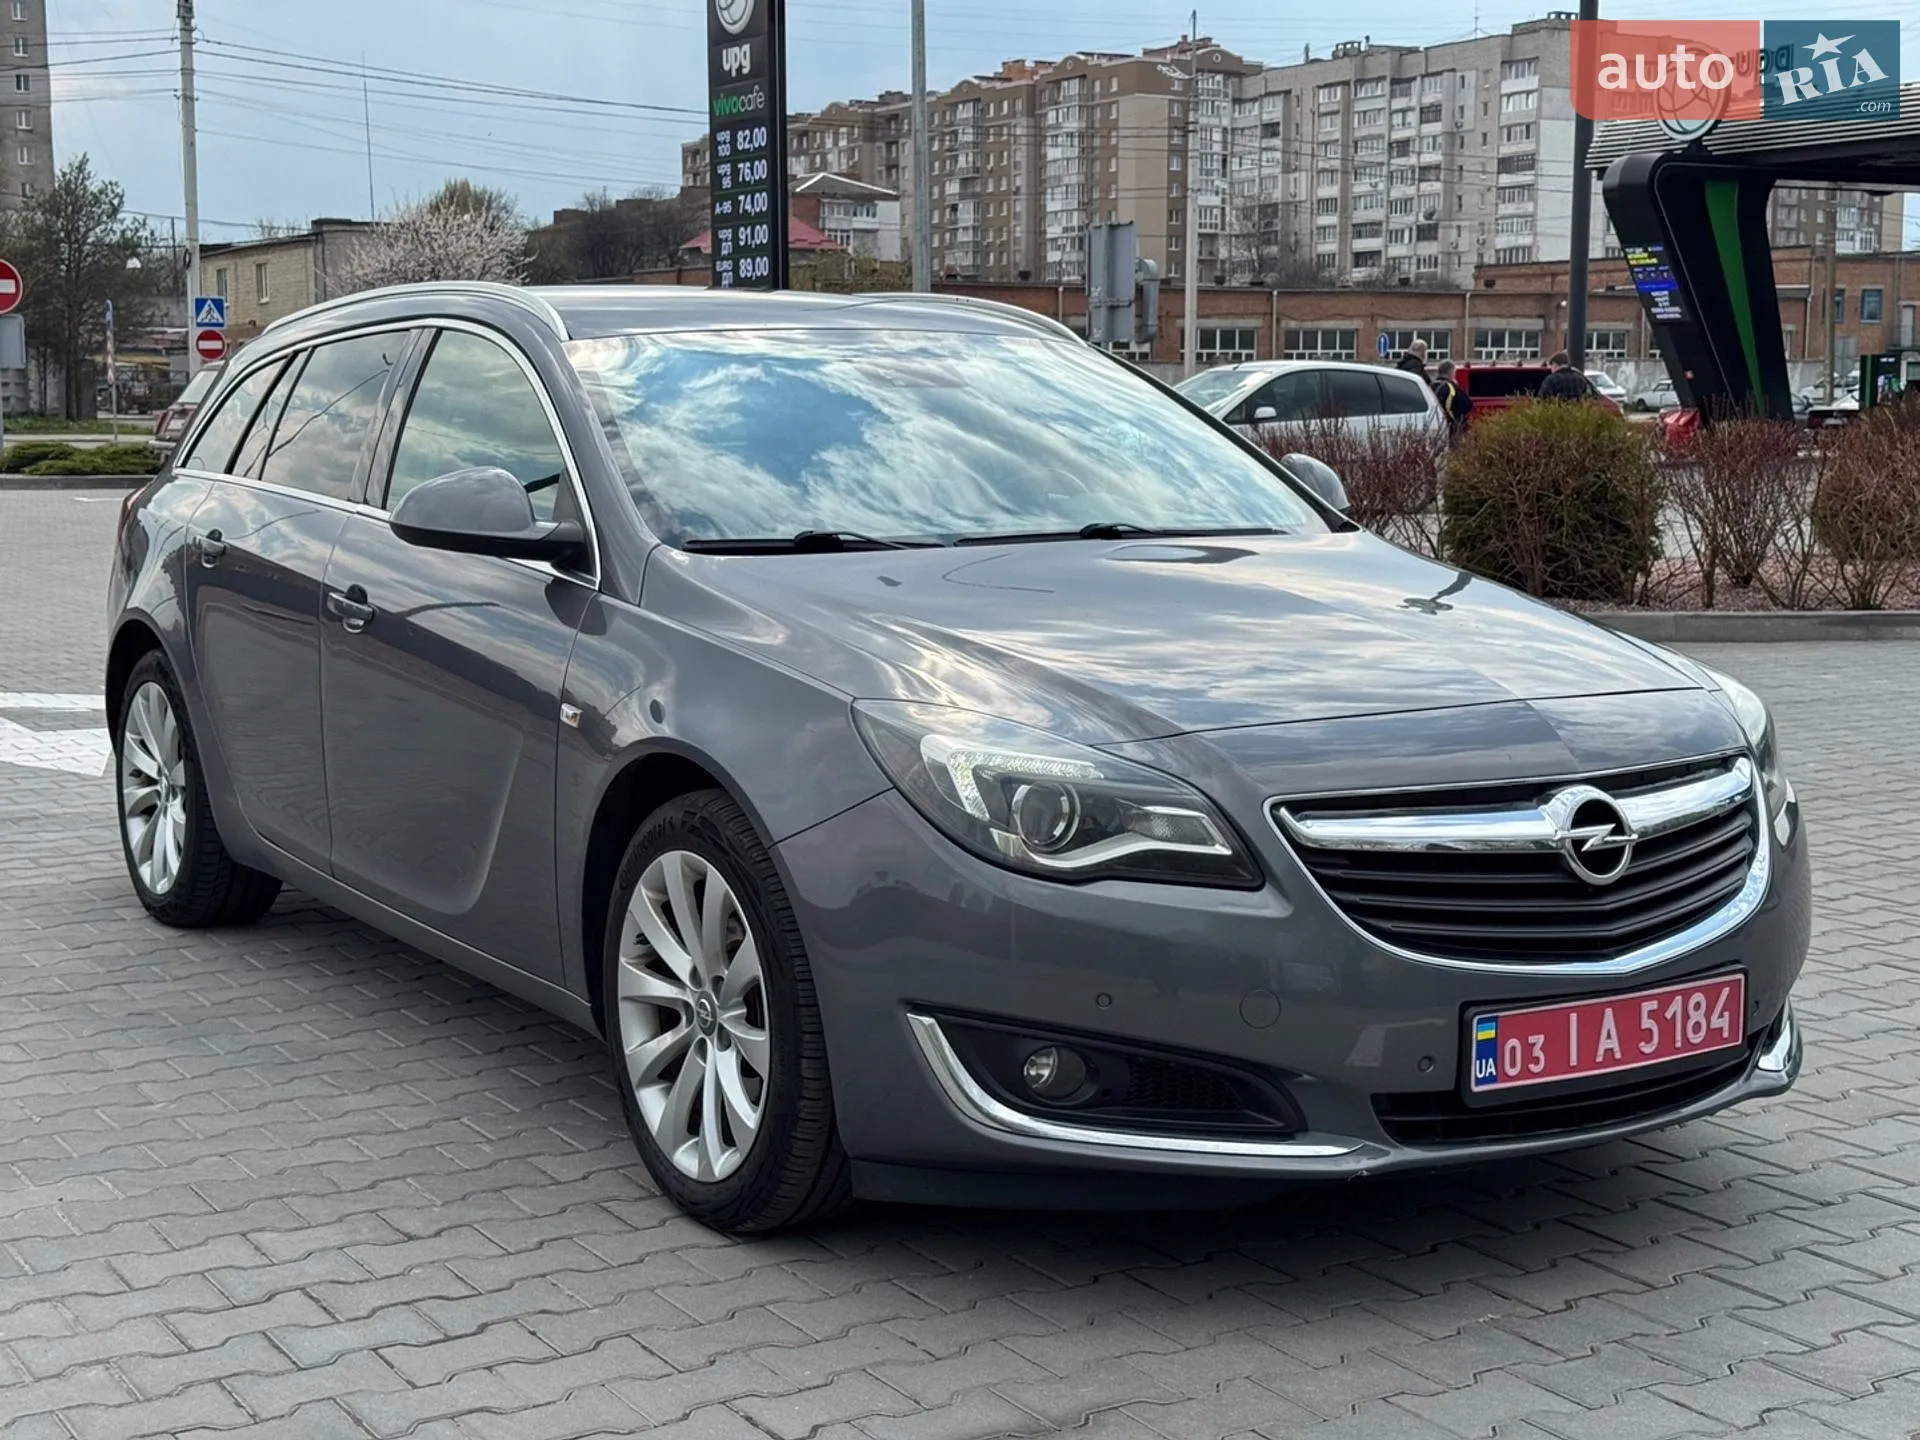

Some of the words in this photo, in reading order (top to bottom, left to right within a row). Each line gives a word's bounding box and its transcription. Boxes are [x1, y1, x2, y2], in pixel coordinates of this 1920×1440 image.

[722, 43, 751, 77] upg
[717, 144, 731, 157] 100
[737, 126, 767, 152] 82,00
[722, 176, 732, 189] 95
[737, 159, 767, 184] 76,00
[738, 191, 768, 216] 74,00
[739, 224, 769, 248] 91,00
[715, 260, 733, 272] EURO
[739, 256, 769, 280] 89,00
[1504, 1034, 1546, 1077] 03
[1638, 987, 1730, 1054] 5184
[1476, 1057, 1497, 1078] UA
